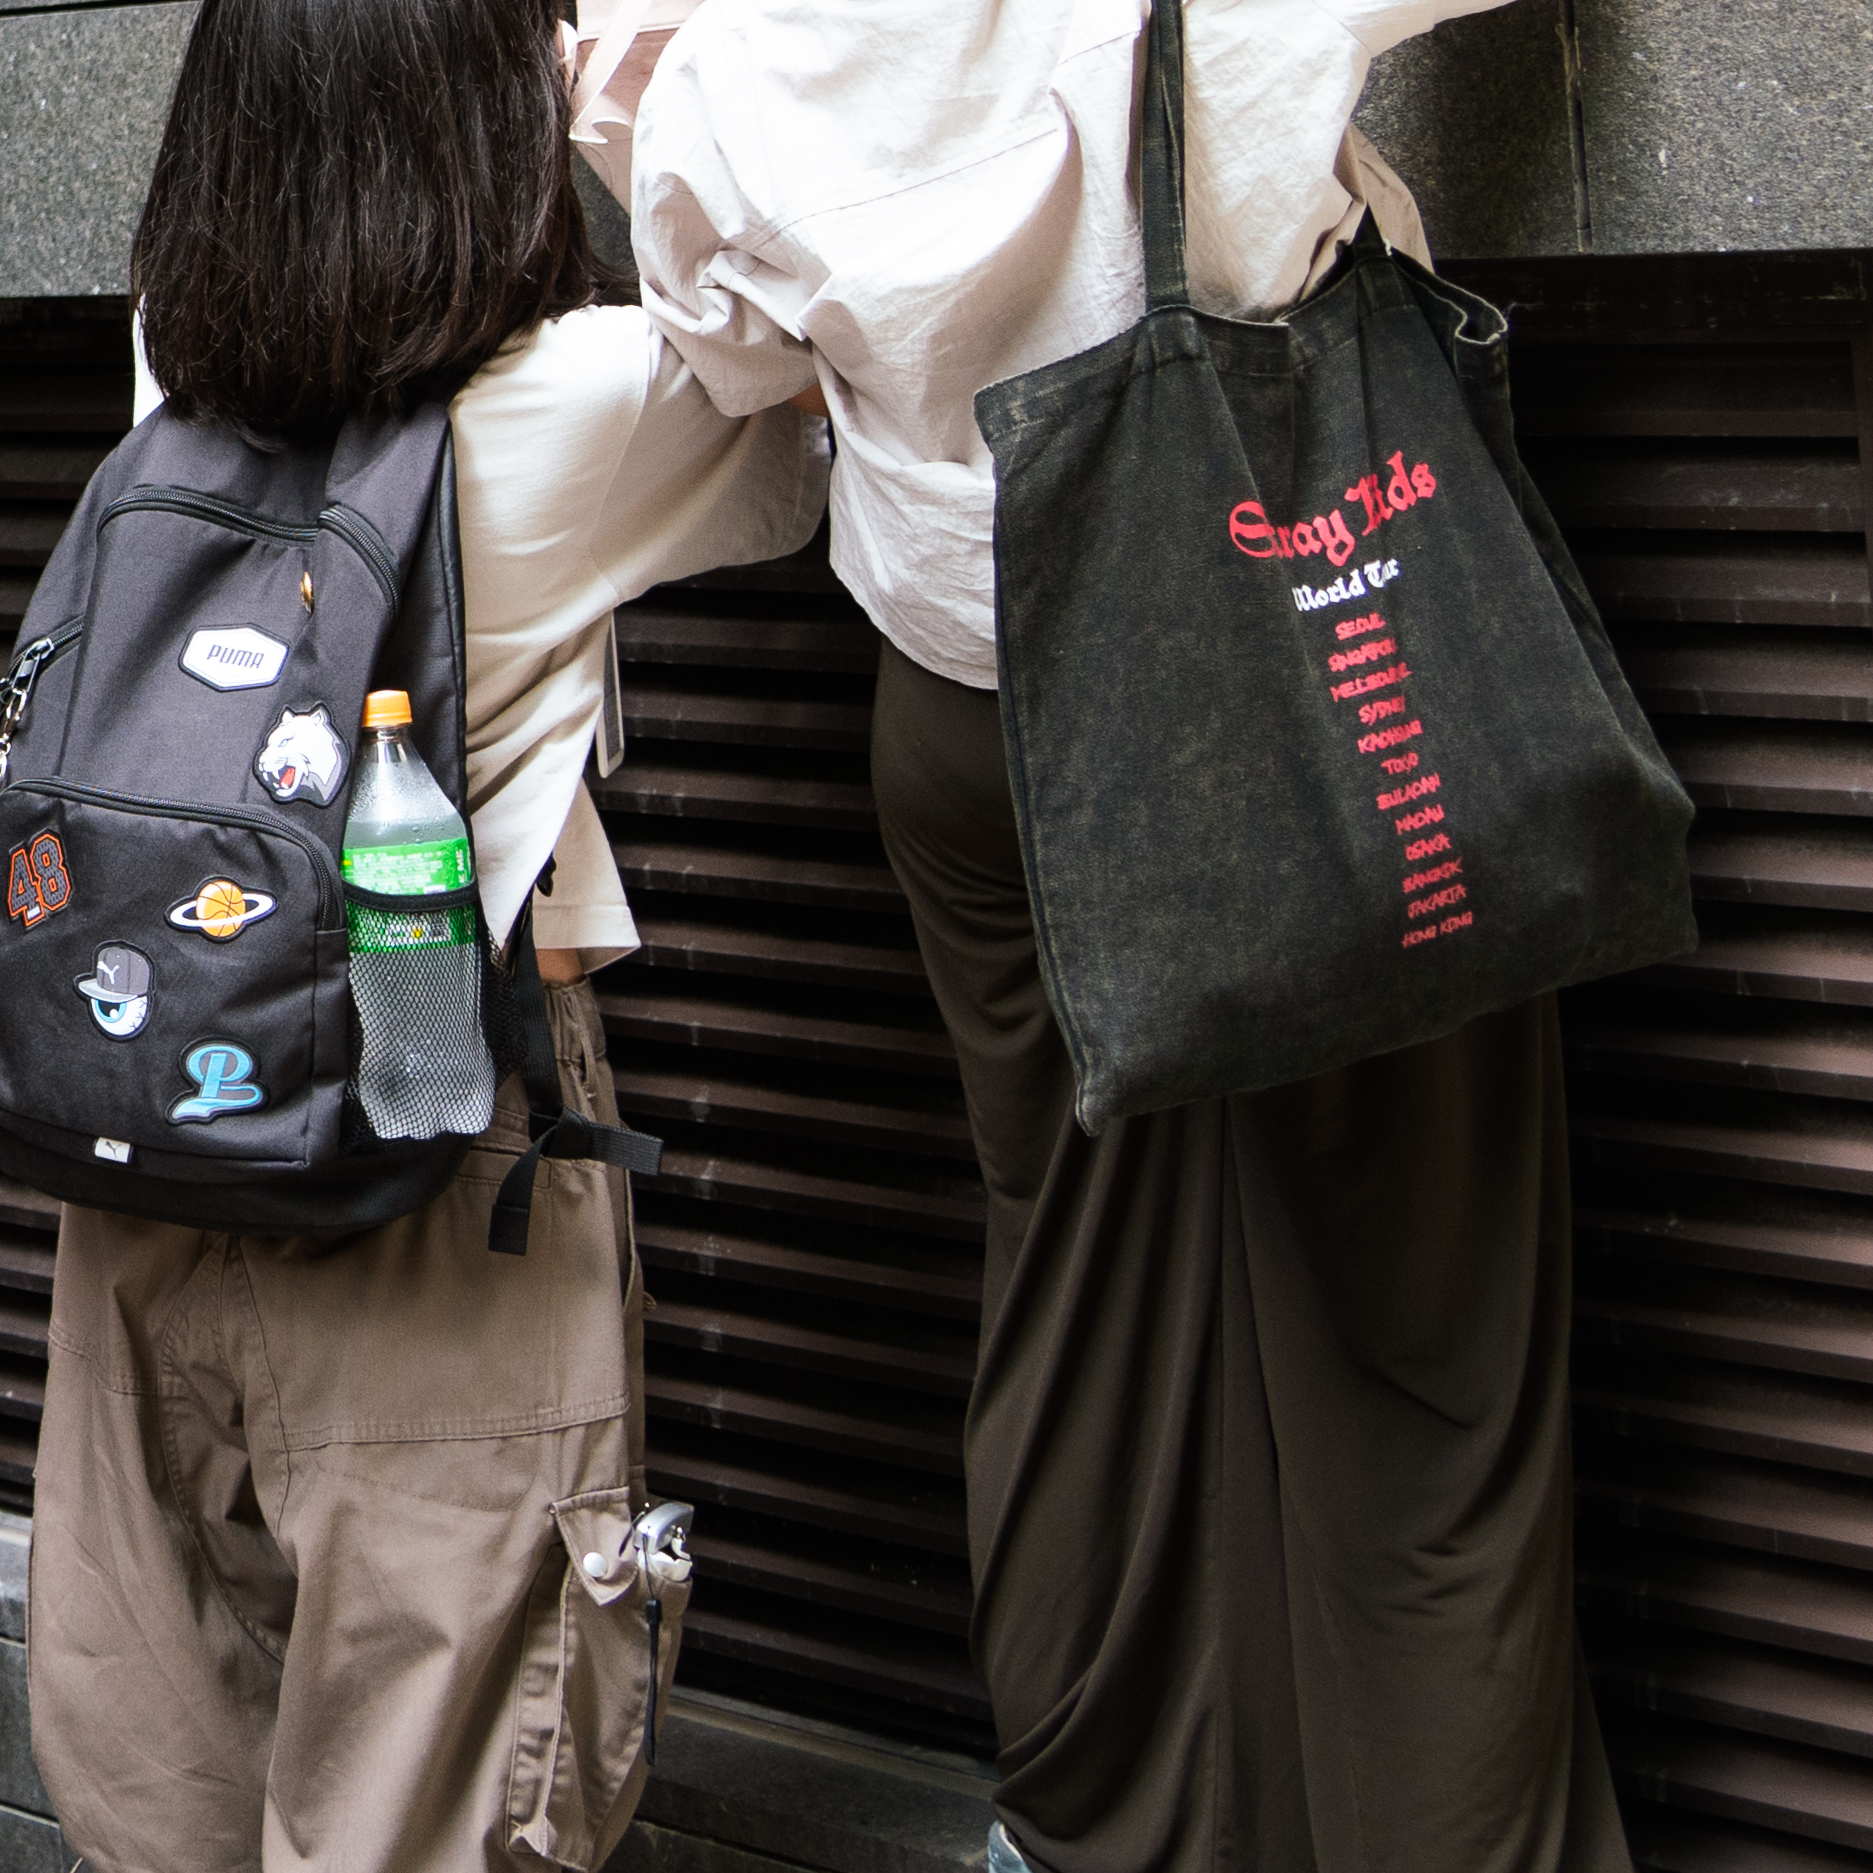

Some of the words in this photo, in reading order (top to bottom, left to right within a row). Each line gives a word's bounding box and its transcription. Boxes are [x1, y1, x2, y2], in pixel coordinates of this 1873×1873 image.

[1229, 500, 1355, 567] Sray
[1292, 568, 1366, 612] World
[1364, 558, 1401, 588] Tr
[206, 644, 265, 669] PUMA
[7, 833, 72, 927] 48
